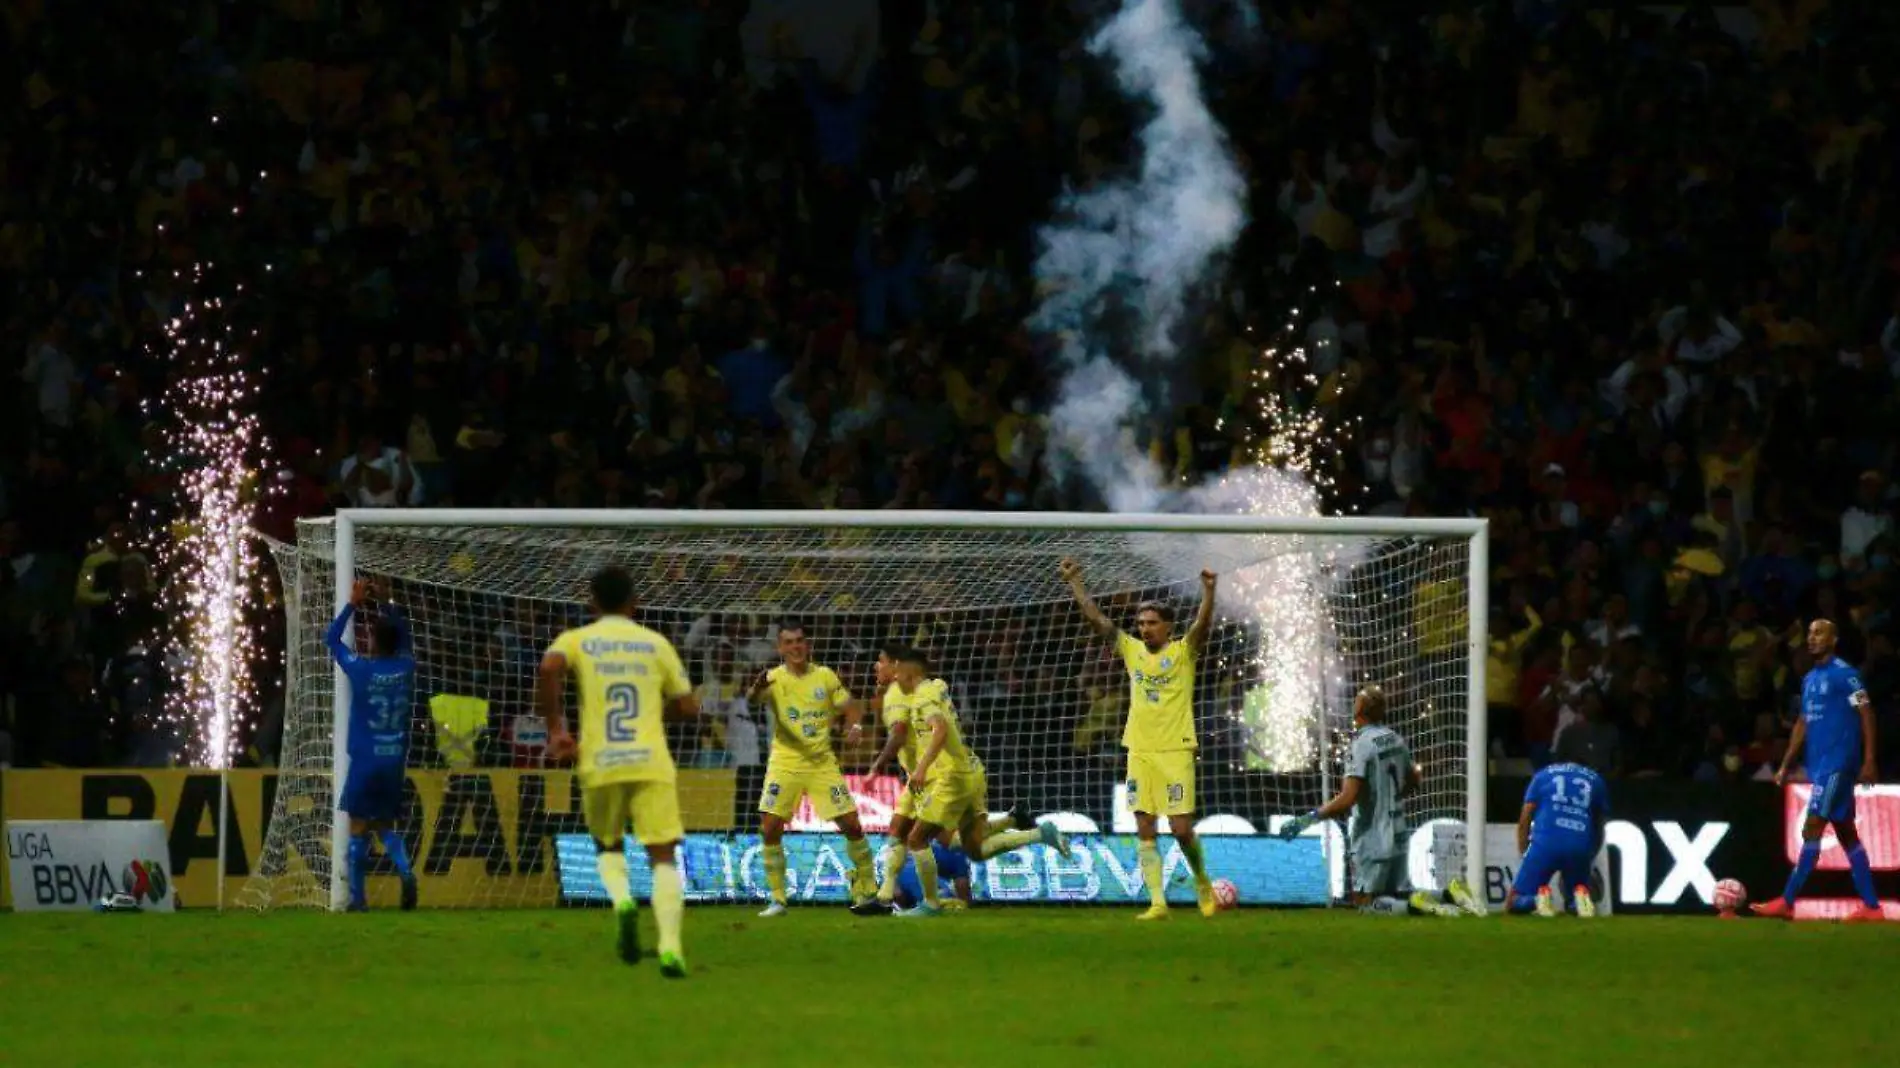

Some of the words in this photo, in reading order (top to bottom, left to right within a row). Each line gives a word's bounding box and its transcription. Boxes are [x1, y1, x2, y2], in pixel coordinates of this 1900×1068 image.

[606, 682, 640, 743] 2
[1552, 774, 1592, 808] 13
[8, 832, 53, 859] LIGA
[33, 860, 117, 904] BBVA
